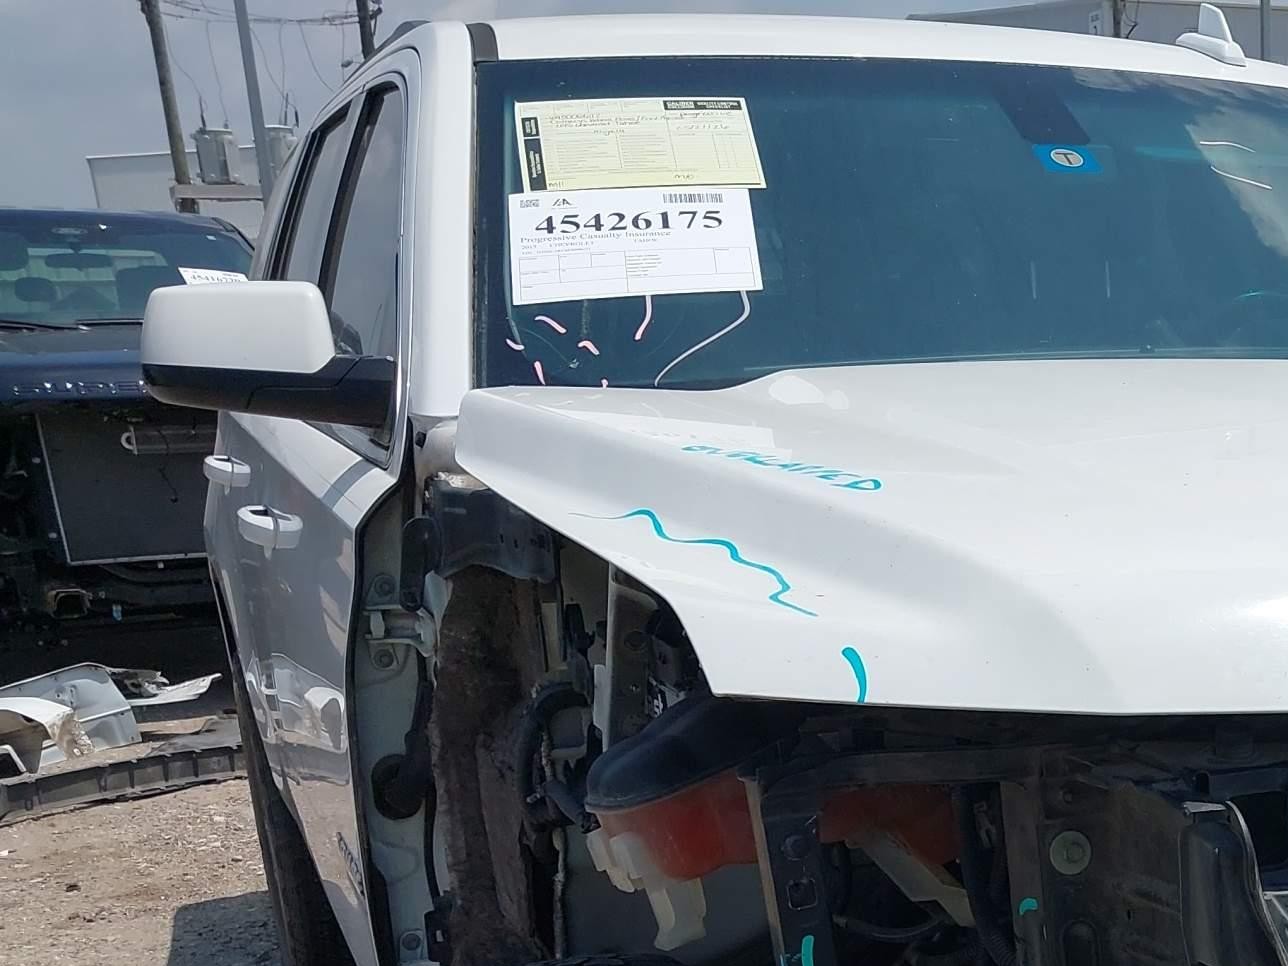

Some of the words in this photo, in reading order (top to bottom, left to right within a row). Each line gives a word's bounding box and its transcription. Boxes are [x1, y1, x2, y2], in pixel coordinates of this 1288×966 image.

[535, 210, 723, 234] 45426175
[520, 234, 577, 244] Progressive
[579, 232, 622, 240] Casualty
